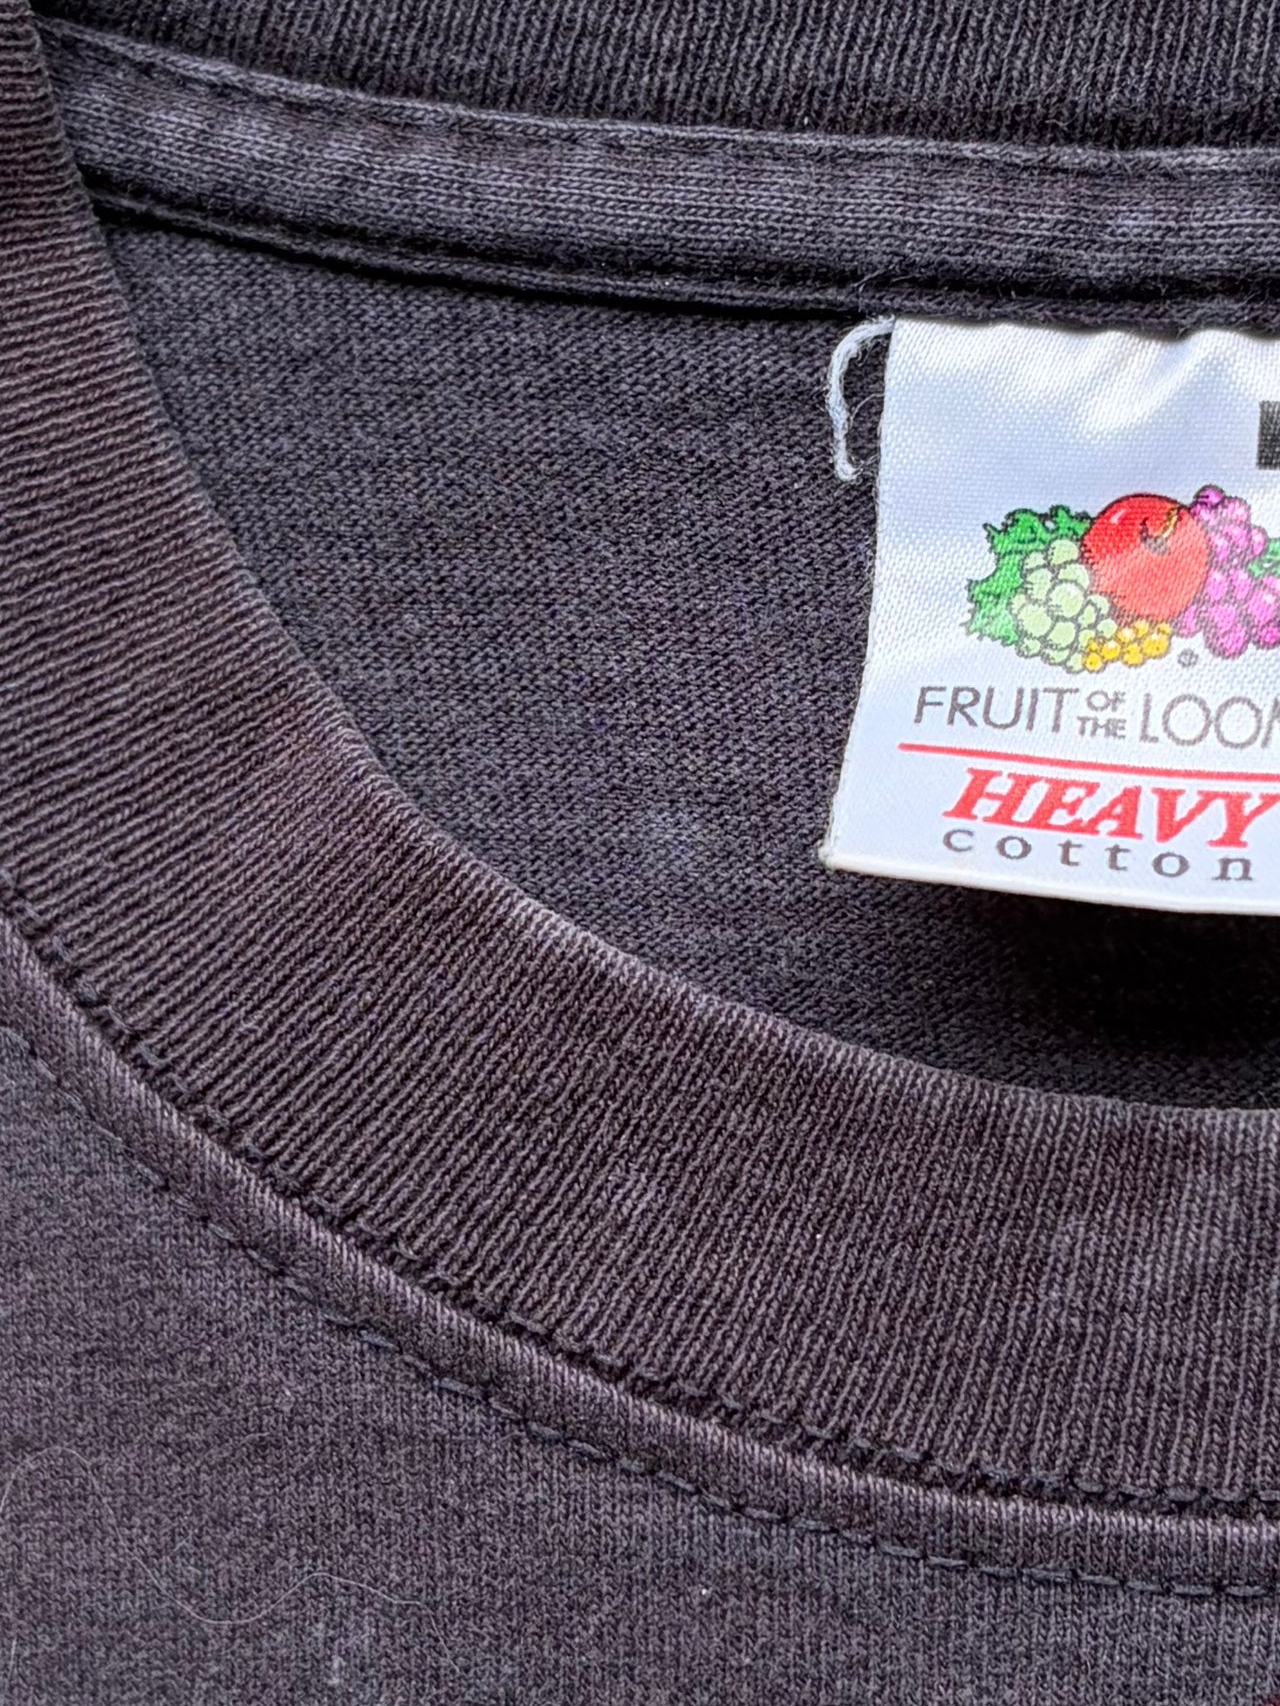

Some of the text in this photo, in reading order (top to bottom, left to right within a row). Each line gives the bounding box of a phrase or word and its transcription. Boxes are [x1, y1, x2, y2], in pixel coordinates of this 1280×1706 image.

[913, 686, 1079, 733] FRUIT
[1086, 689, 1126, 713] OF
[1077, 716, 1126, 740] THE
[942, 828, 1254, 882] cotton
